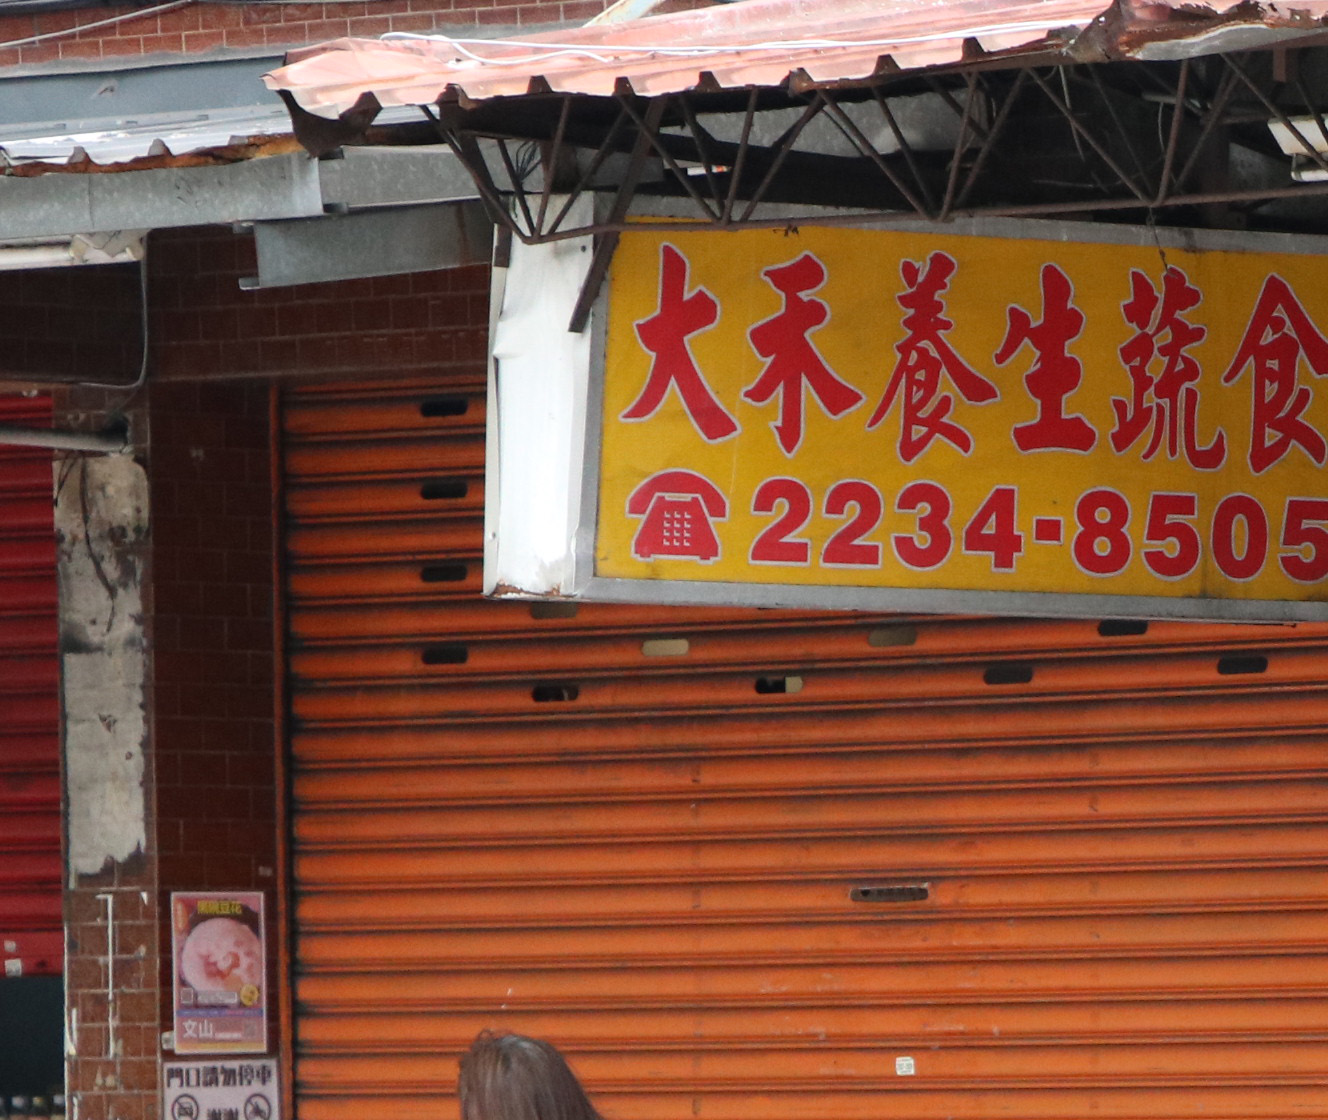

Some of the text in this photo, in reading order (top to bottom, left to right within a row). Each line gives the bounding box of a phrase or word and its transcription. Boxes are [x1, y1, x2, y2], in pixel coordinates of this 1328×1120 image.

[183, 1020, 213, 1037] 文山
[167, 1064, 272, 1088] 門口請勿停車
